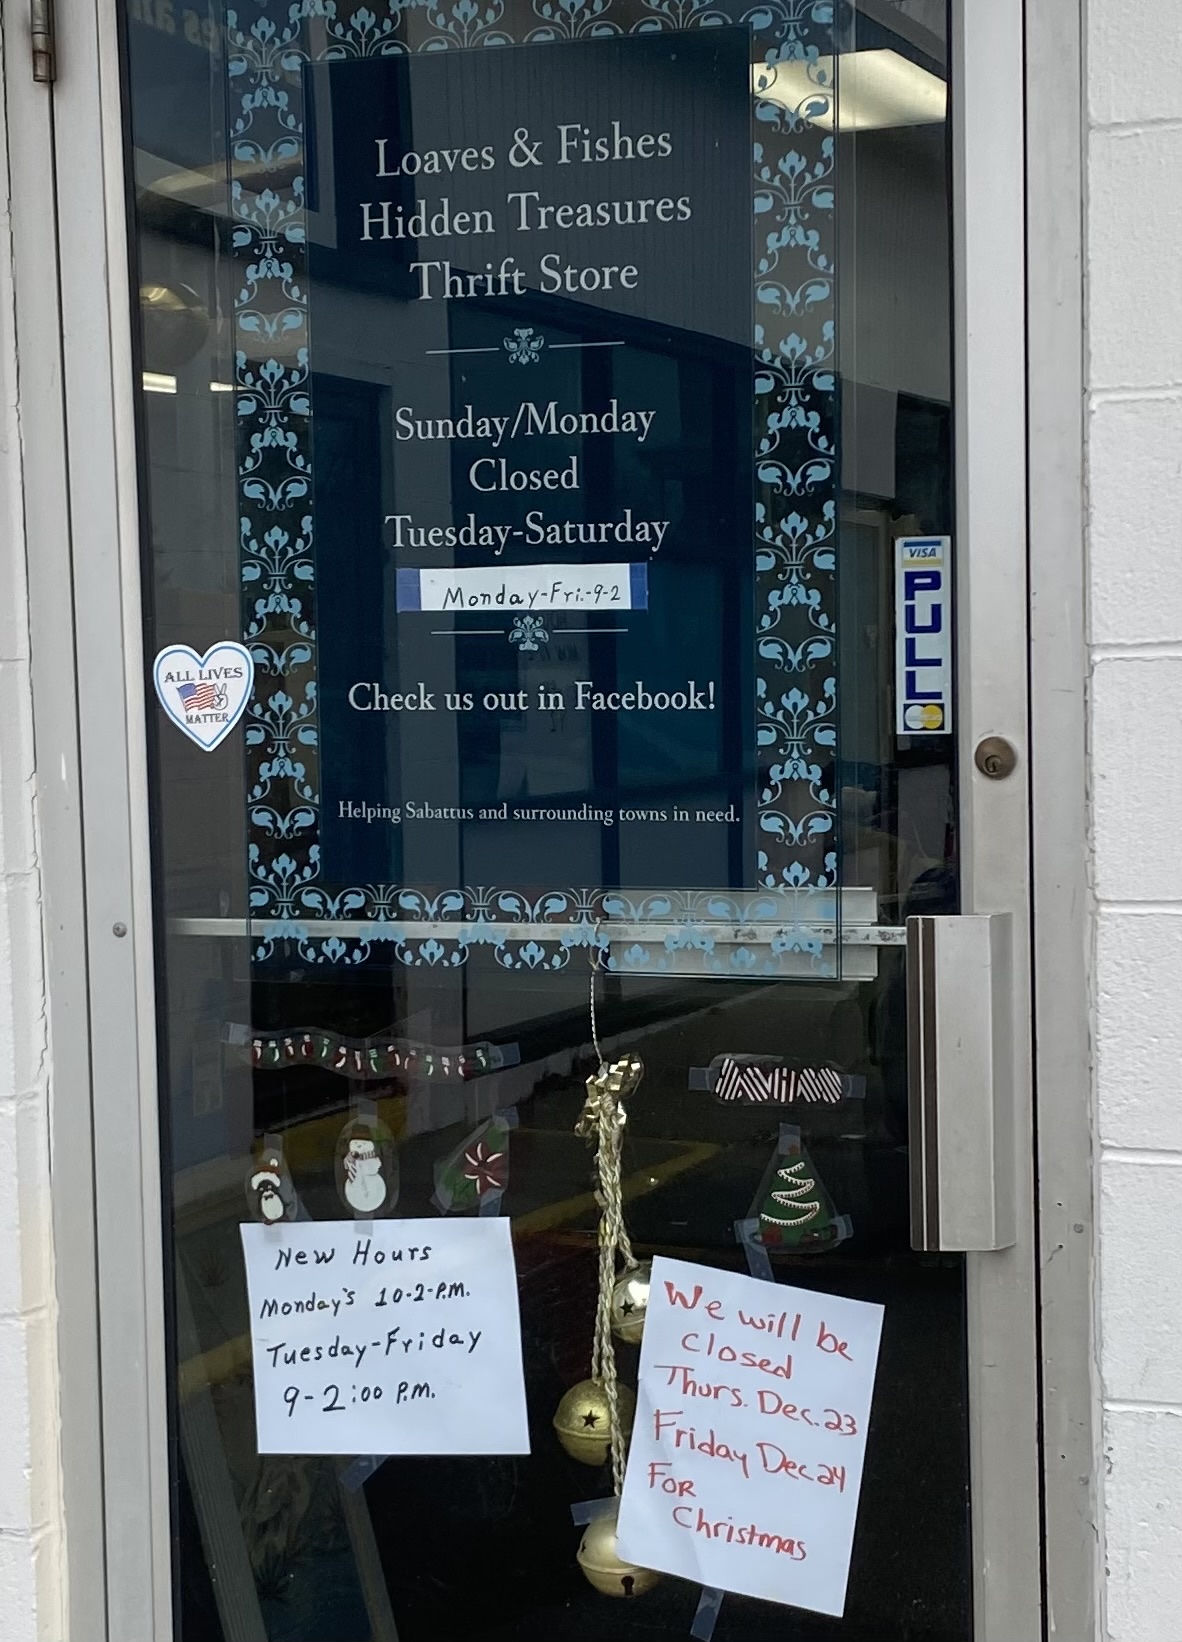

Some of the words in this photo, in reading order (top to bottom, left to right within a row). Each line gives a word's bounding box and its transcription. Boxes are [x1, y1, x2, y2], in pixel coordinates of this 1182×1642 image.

[374, 137, 496, 177] Loaves
[508, 127, 544, 168] &
[556, 121, 674, 165] Fishes
[359, 198, 496, 241] Hidden
[506, 190, 693, 232] Treasures
[408, 256, 528, 300] Thrift
[539, 253, 639, 294] Store
[394, 398, 656, 448] Sunday/Monday
[468, 455, 581, 492] Closed
[383, 508, 671, 556] Tuesday-Saturday
[908, 547, 937, 559] VISA
[904, 570, 943, 701] PULL
[164, 670, 195, 683] ALL
[198, 666, 244, 681] LIVES
[347, 682, 437, 712] Check
[444, 691, 475, 711] us
[482, 689, 530, 711] out
[537, 685, 567, 711] in
[574, 680, 716, 710] Facebook!
[185, 712, 230, 725] MATTER
[337, 801, 402, 824] Helping
[404, 800, 475, 821] Sabattus
[478, 802, 508, 821] and
[513, 803, 614, 827] surrounding
[618, 807, 668, 823] towns
[672, 806, 690, 822] in
[695, 803, 741, 823] need.
[274, 1246, 336, 1271] New
[352, 1238, 432, 1266] Hours
[259, 1286, 356, 1319] Monday's
[663, 1280, 725, 1322] We
[737, 1311, 802, 1342] will
[815, 1321, 854, 1362] be
[653, 1364, 749, 1408] Thurs.
[653, 1408, 750, 1479] Friday
[672, 1505, 808, 1562] Christmas
